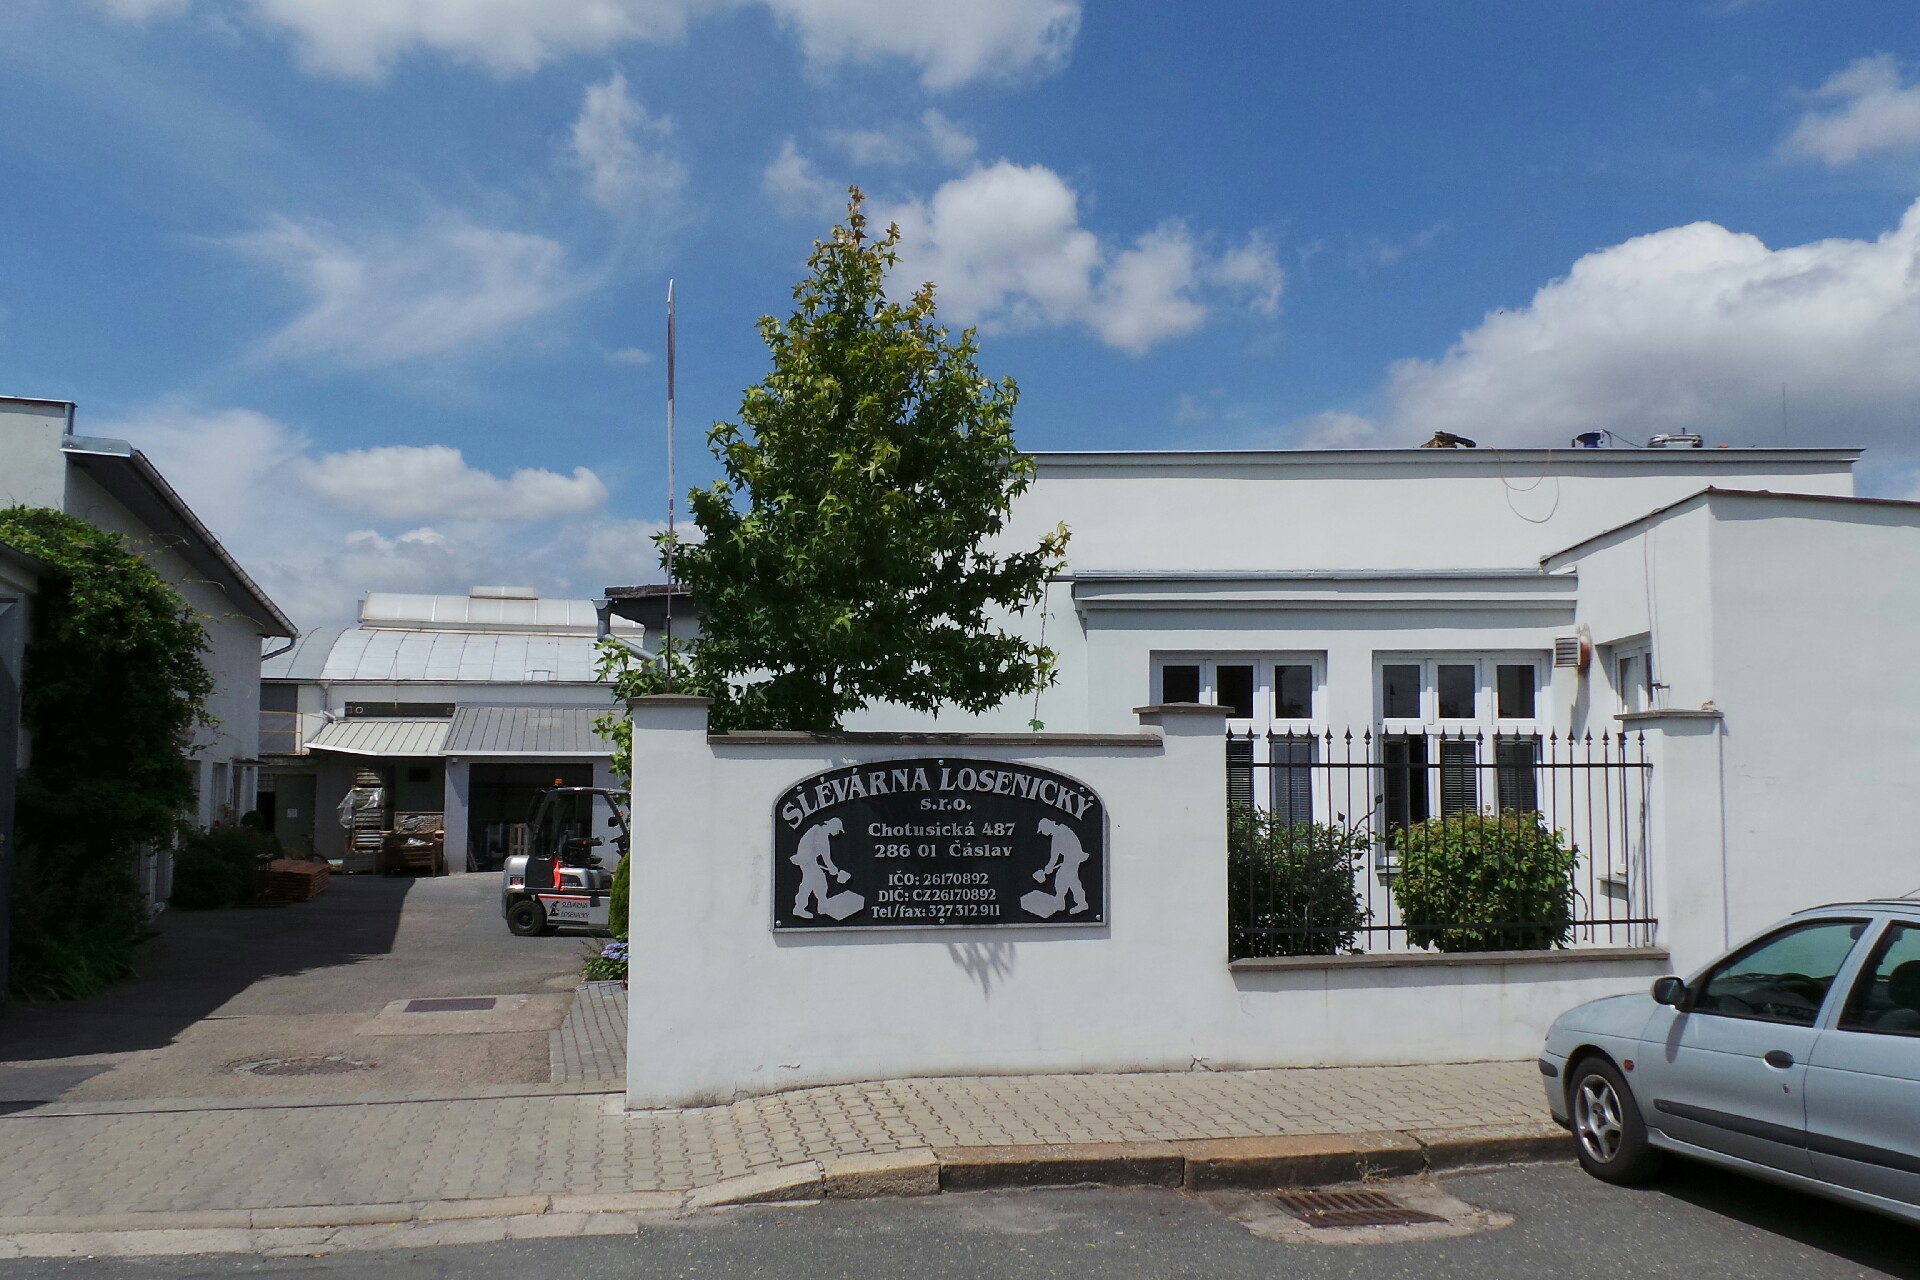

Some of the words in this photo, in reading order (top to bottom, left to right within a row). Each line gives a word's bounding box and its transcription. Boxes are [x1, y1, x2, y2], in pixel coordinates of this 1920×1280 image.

[782, 768, 930, 830] SLÉVÁRNA
[939, 767, 1094, 821] LOSENICKÝ
[920, 798, 972, 811] s.r.o.
[868, 822, 976, 837] Chotusická
[982, 822, 1016, 836] 487
[874, 844, 911, 858] 286
[918, 844, 936, 858] 01
[949, 840, 1013, 857] Čáslav
[888, 870, 920, 886] IČO:
[923, 873, 989, 885] 26170892
[878, 887, 909, 902] DIČ:
[912, 889, 997, 901] CZ26170892
[871, 904, 926, 918] Tel/fax:
[928, 905, 953, 917] 327
[955, 905, 978, 916] 312
[980, 904, 1001, 916] 911
